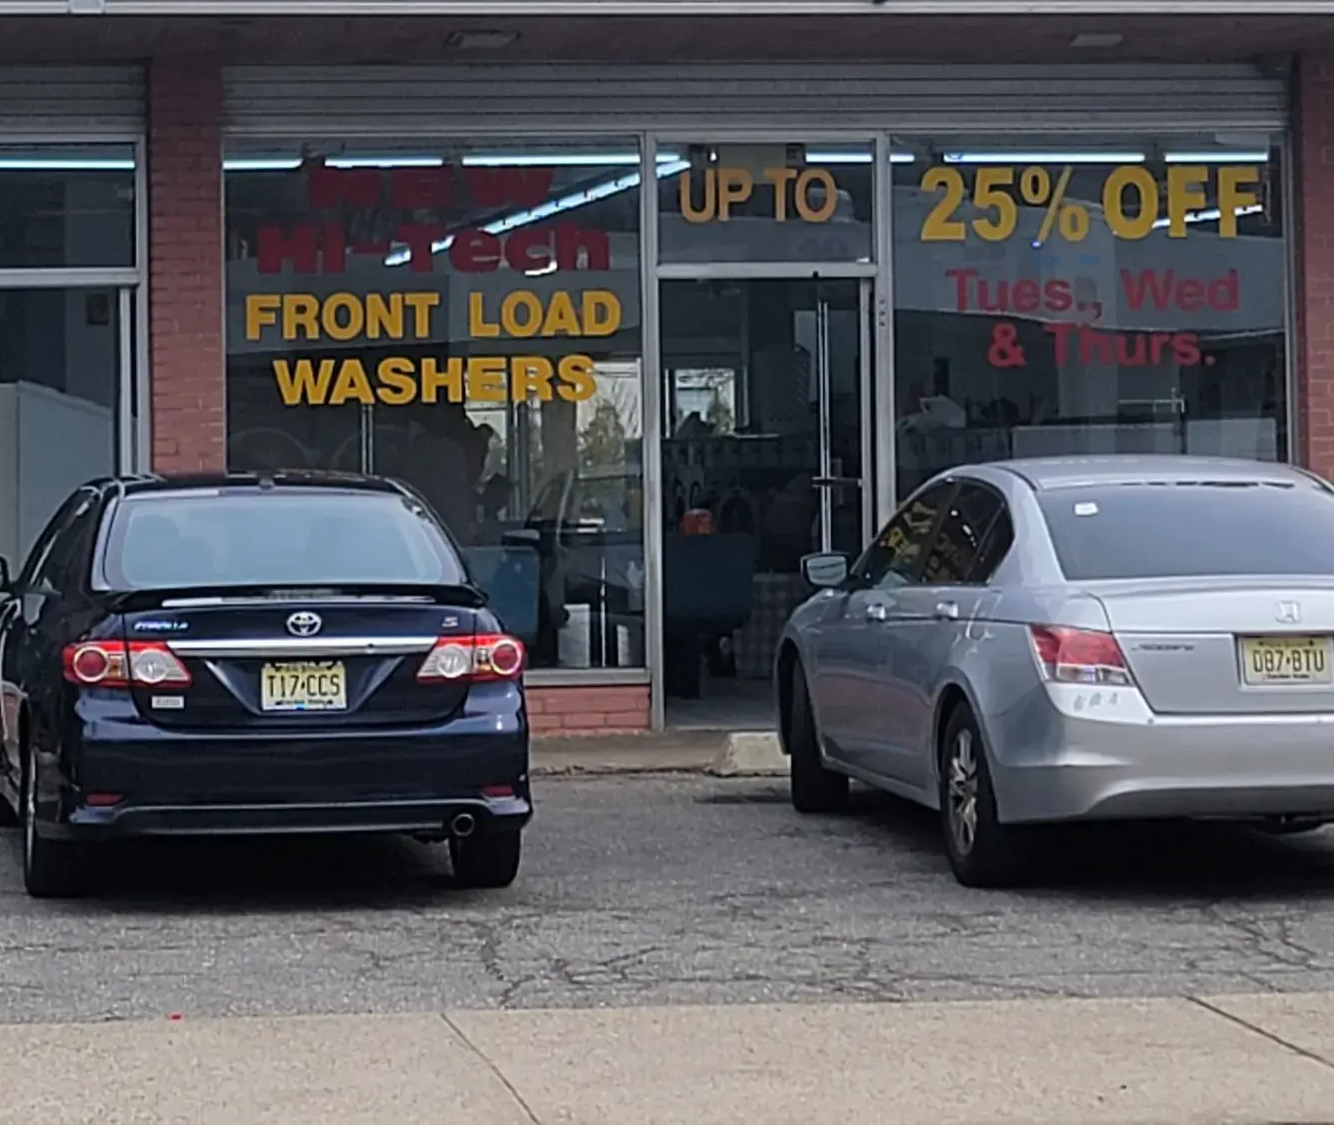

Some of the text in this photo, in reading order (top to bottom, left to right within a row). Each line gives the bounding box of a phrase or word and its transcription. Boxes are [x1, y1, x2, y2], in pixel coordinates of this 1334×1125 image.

[679, 167, 838, 223] UP TO
[920, 165, 1262, 242] 25% OFF
[244, 288, 623, 342] FRONT LOAD
[1121, 268, 1241, 313] Wed
[986, 322, 1217, 369] & Thurs.
[272, 353, 599, 407] WASHERS
